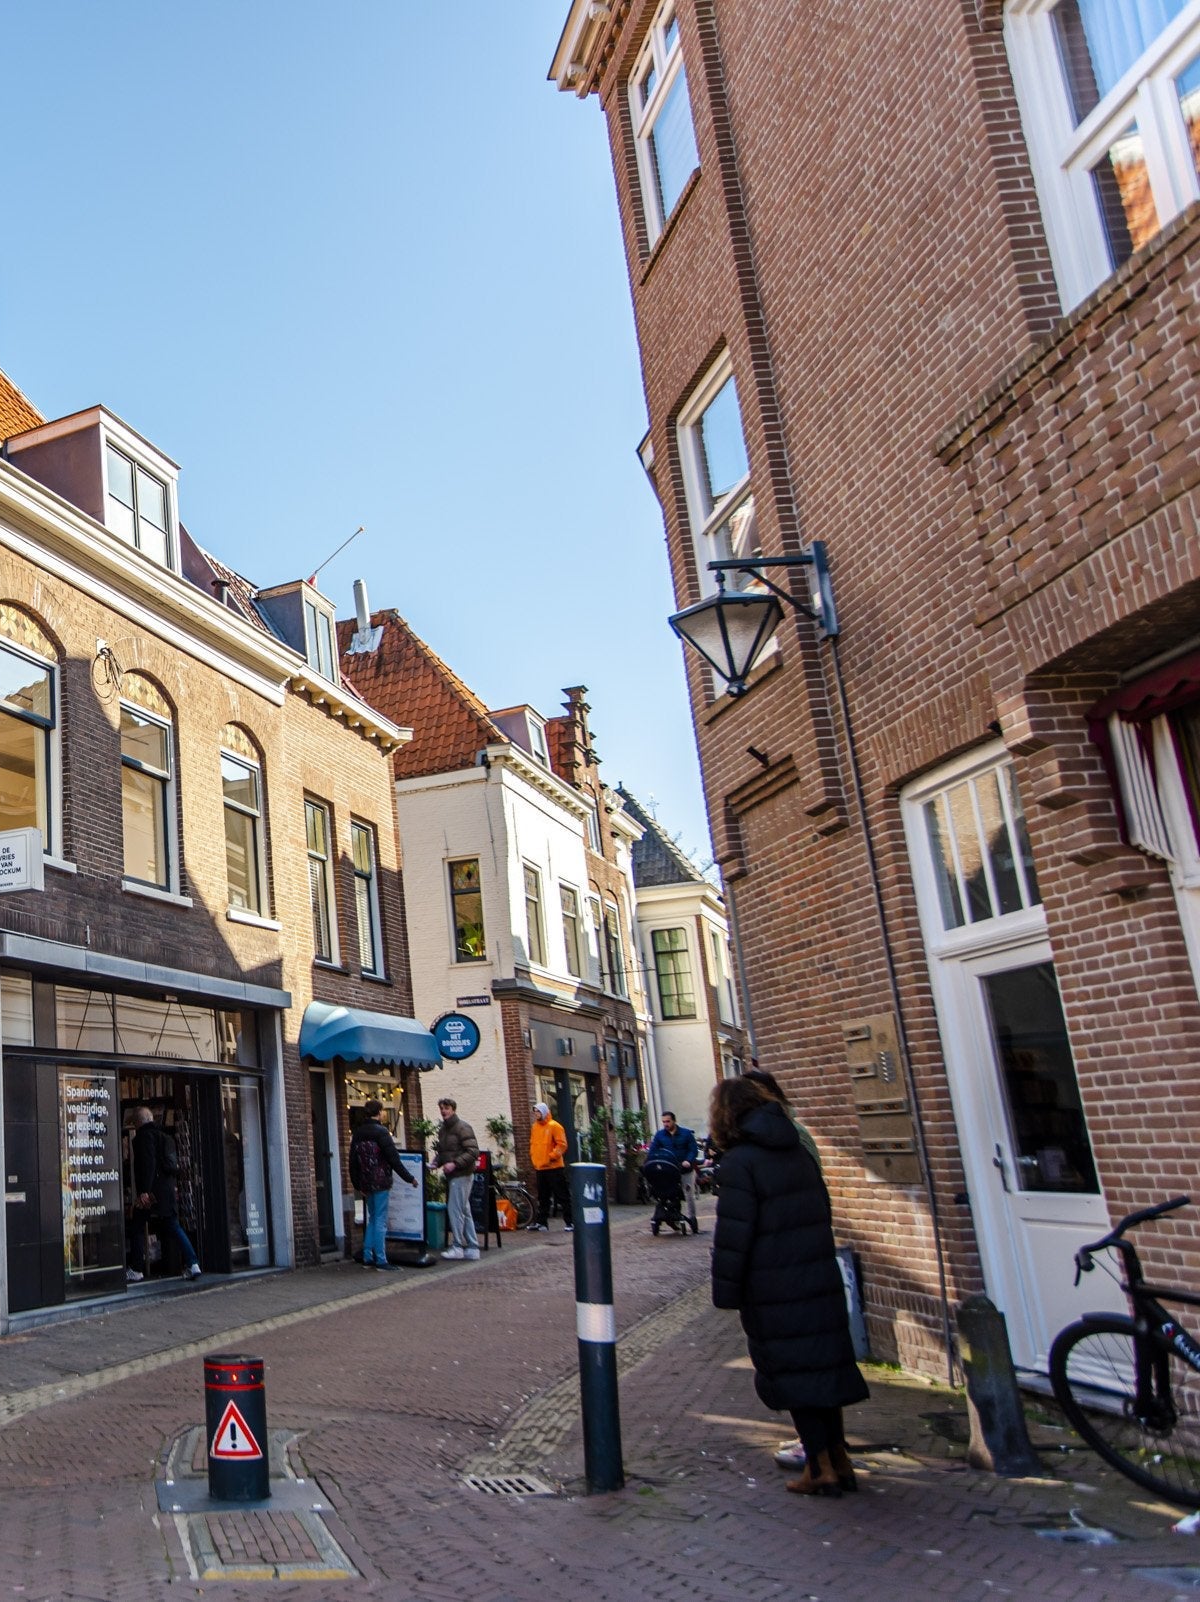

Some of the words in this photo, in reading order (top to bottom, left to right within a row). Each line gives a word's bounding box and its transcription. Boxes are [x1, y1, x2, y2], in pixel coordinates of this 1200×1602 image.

[67, 1086, 110, 1099] Spannende,
[67, 1102, 108, 1116] veelzijdige,
[68, 1119, 106, 1134] griezelige,
[69, 1136, 105, 1149] klassieke,
[69, 1154, 93, 1165] sterke
[94, 1155, 104, 1165] en
[70, 1170, 119, 1183] meeslepende
[70, 1187, 103, 1200] verhalen
[70, 1204, 106, 1218] beginnen
[71, 1222, 87, 1234] hier
